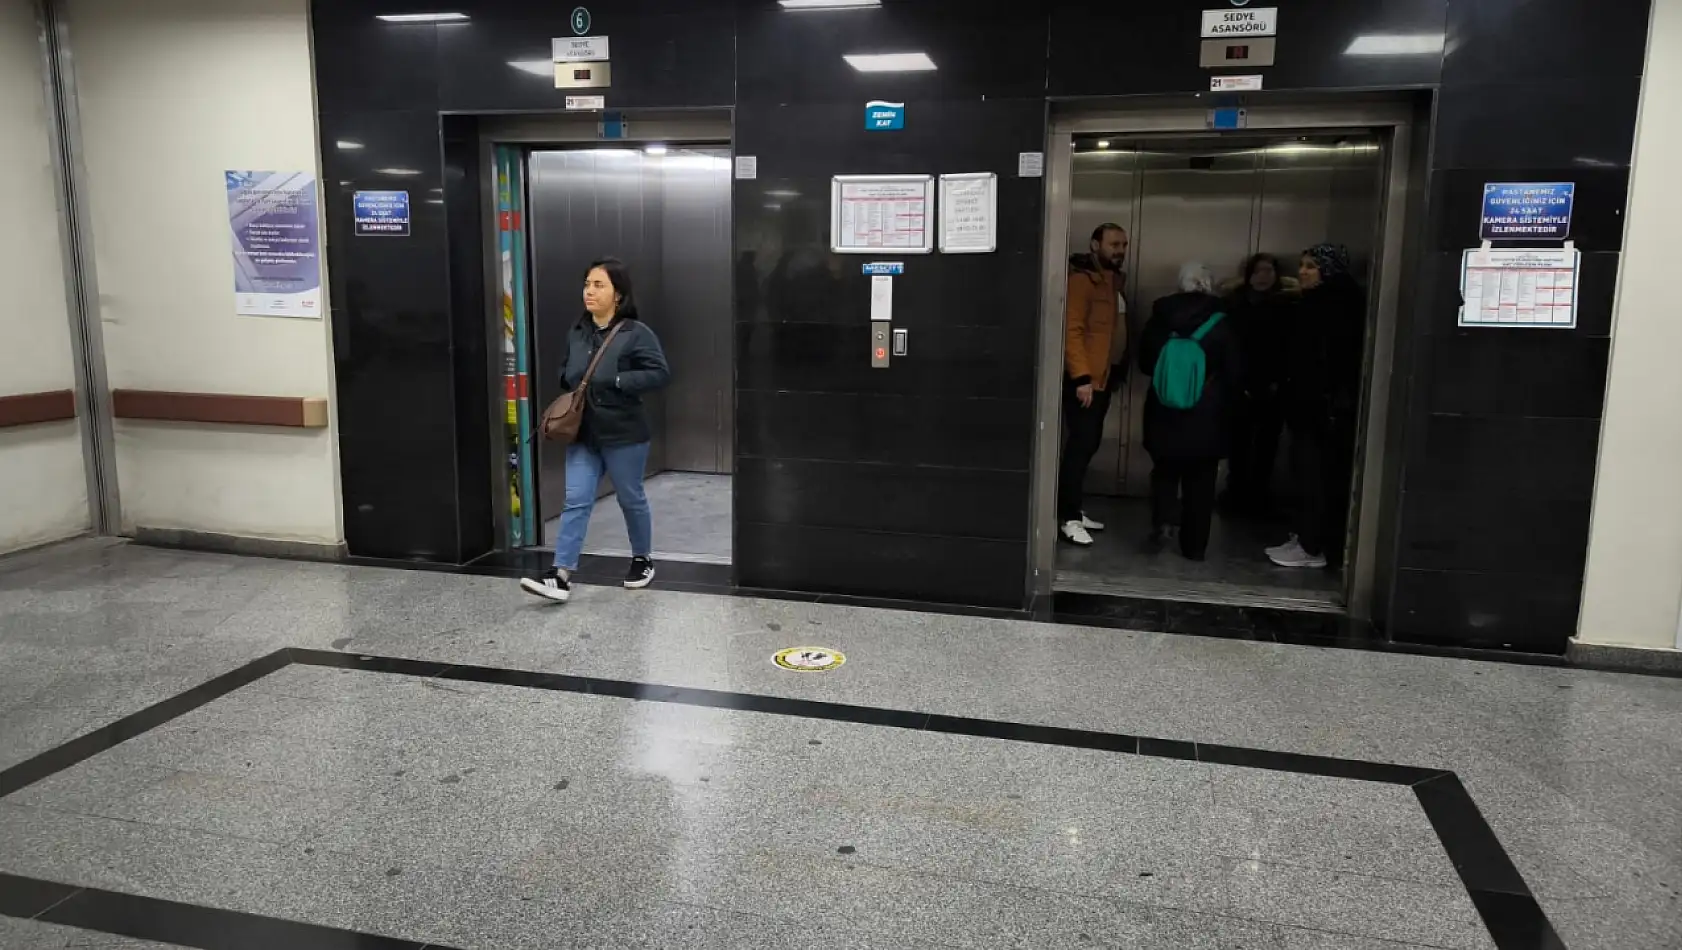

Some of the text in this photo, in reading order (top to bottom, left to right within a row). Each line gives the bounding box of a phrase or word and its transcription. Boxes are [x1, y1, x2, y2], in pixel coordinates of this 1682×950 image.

[576, 12, 583, 29] 6
[1223, 12, 1255, 22] SEDYE
[1211, 21, 1267, 33] ASANSÖRÜ
[872, 110, 897, 119] ZEMİN
[875, 119, 892, 128] KAT
[1483, 214, 1568, 224] KAMERA SİSTEMİYLE
